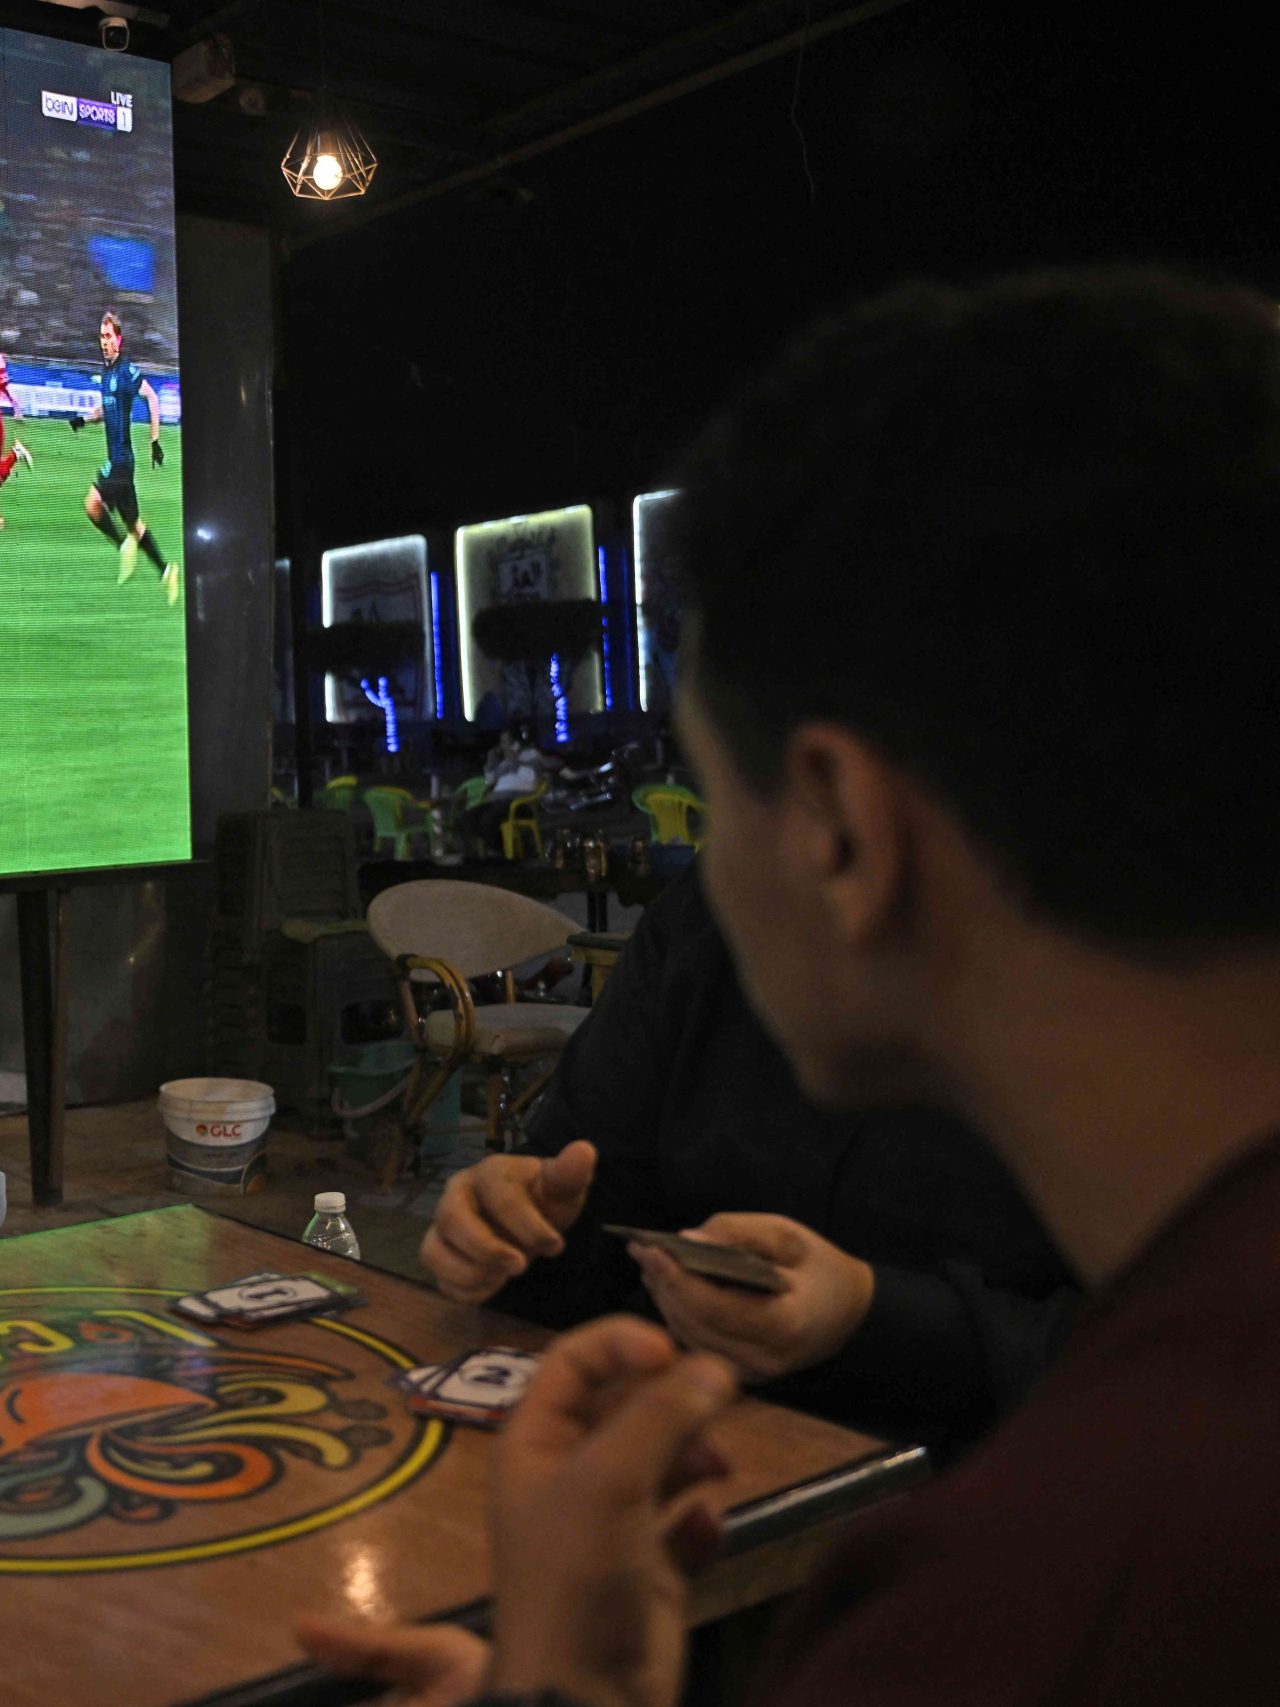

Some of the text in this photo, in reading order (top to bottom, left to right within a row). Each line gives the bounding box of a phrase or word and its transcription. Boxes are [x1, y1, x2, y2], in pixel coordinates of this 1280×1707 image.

[111, 91, 133, 107] LIVE
[78, 103, 116, 124] SPORTS
[210, 1124, 242, 1138] GLC
